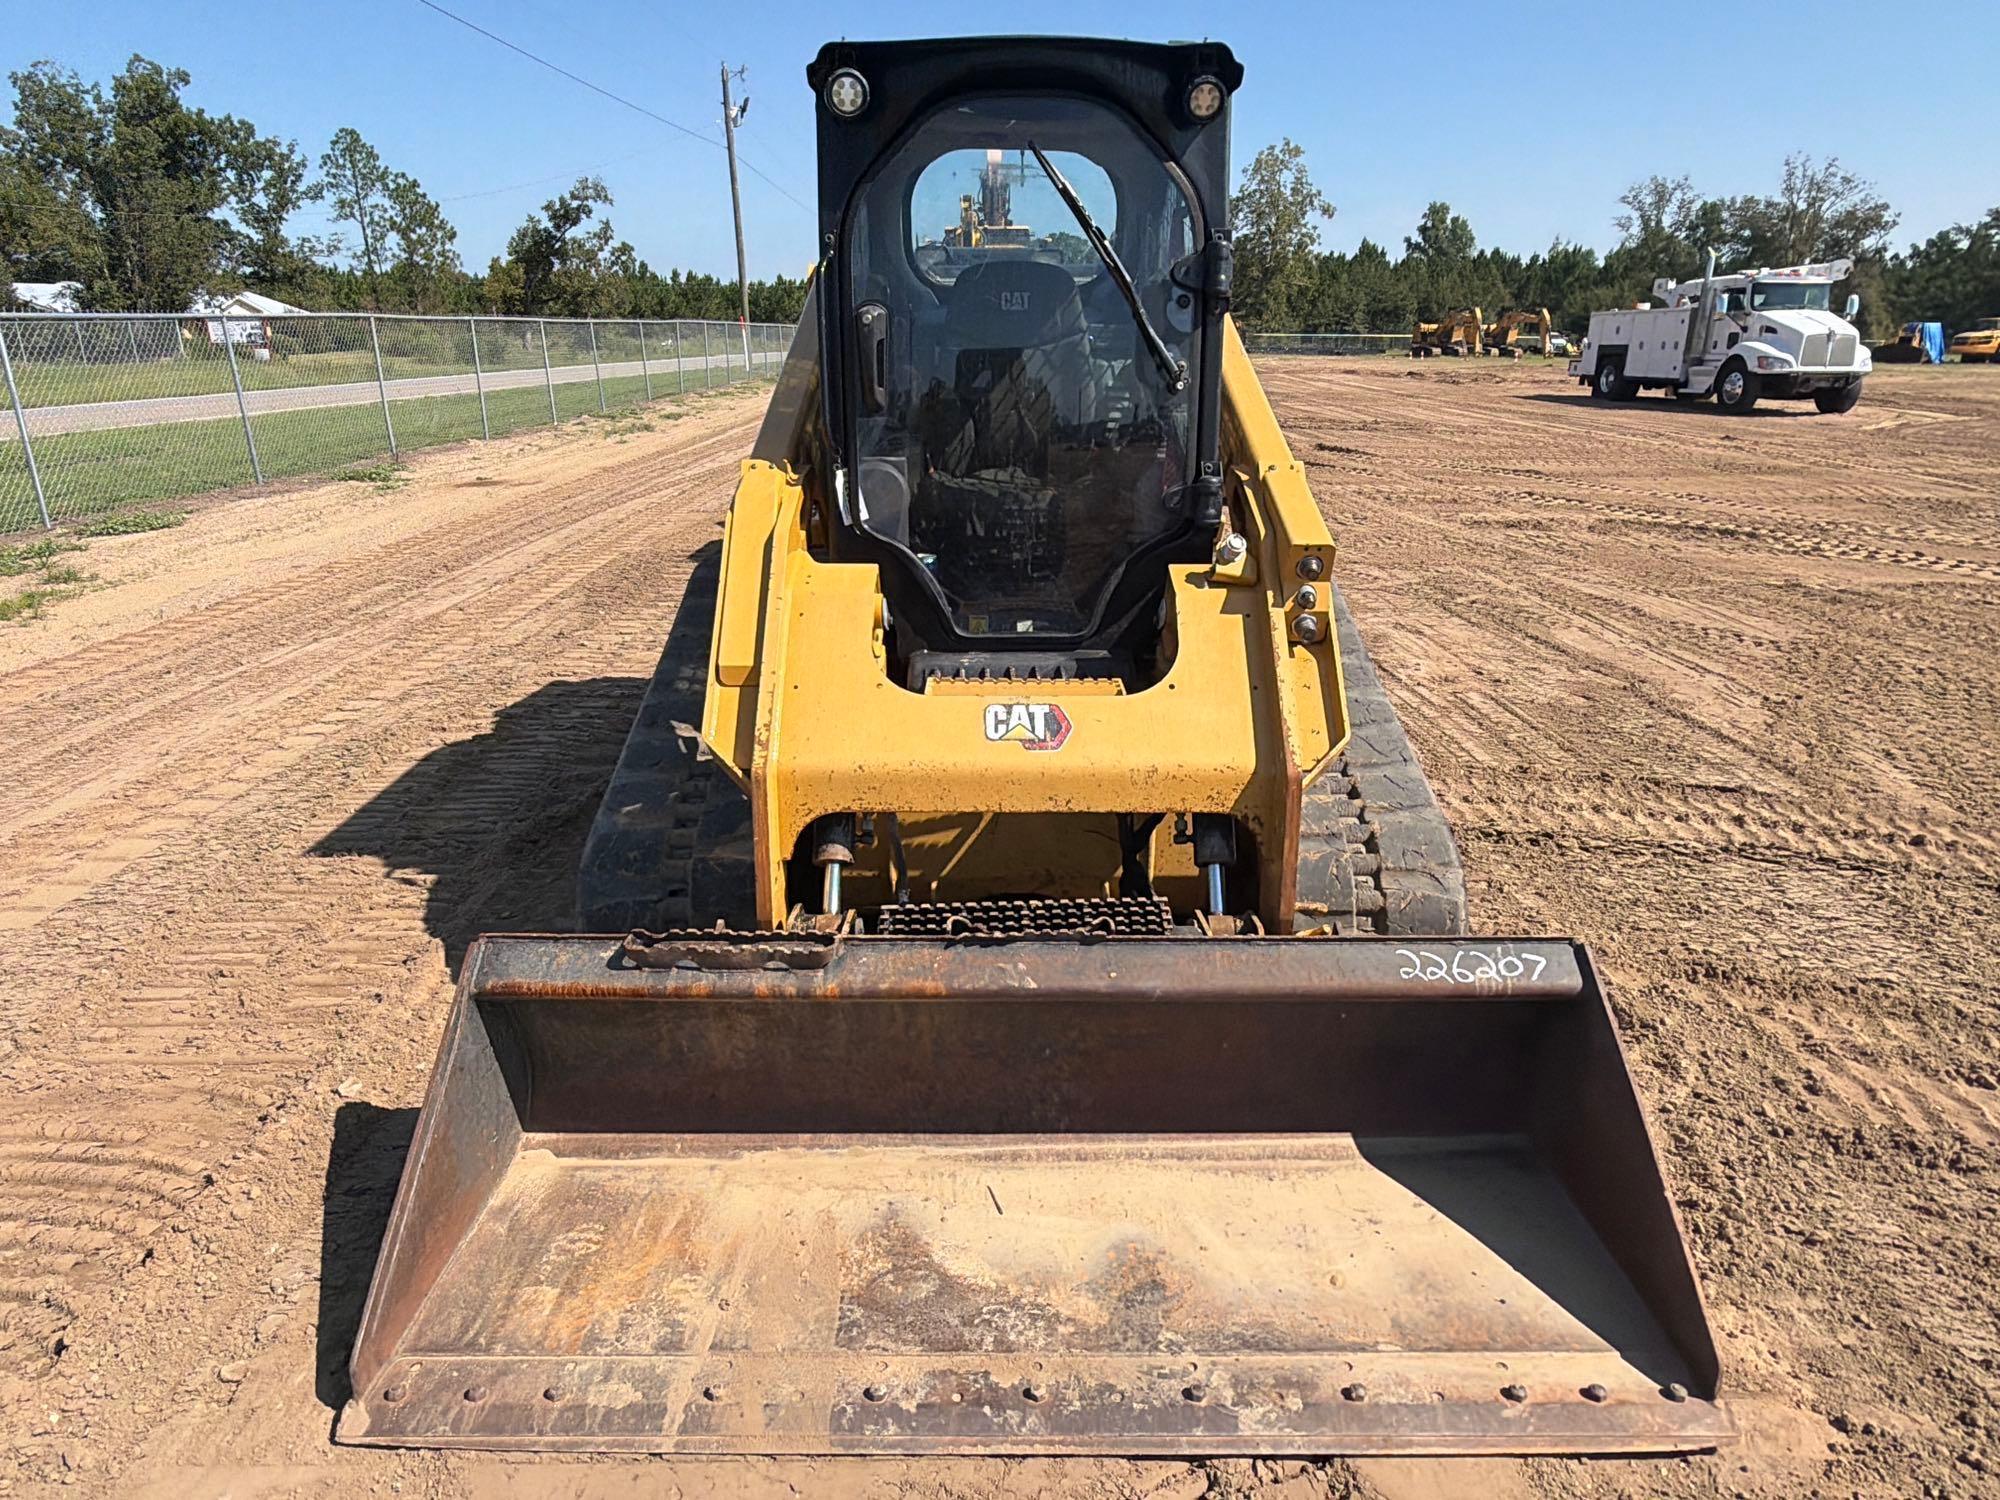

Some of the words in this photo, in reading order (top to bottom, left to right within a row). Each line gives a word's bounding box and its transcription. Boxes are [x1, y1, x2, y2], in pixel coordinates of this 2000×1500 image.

[1000, 291, 1031, 311] CAT
[984, 704, 1050, 741] CAT
[1395, 948, 1547, 985] 226207
